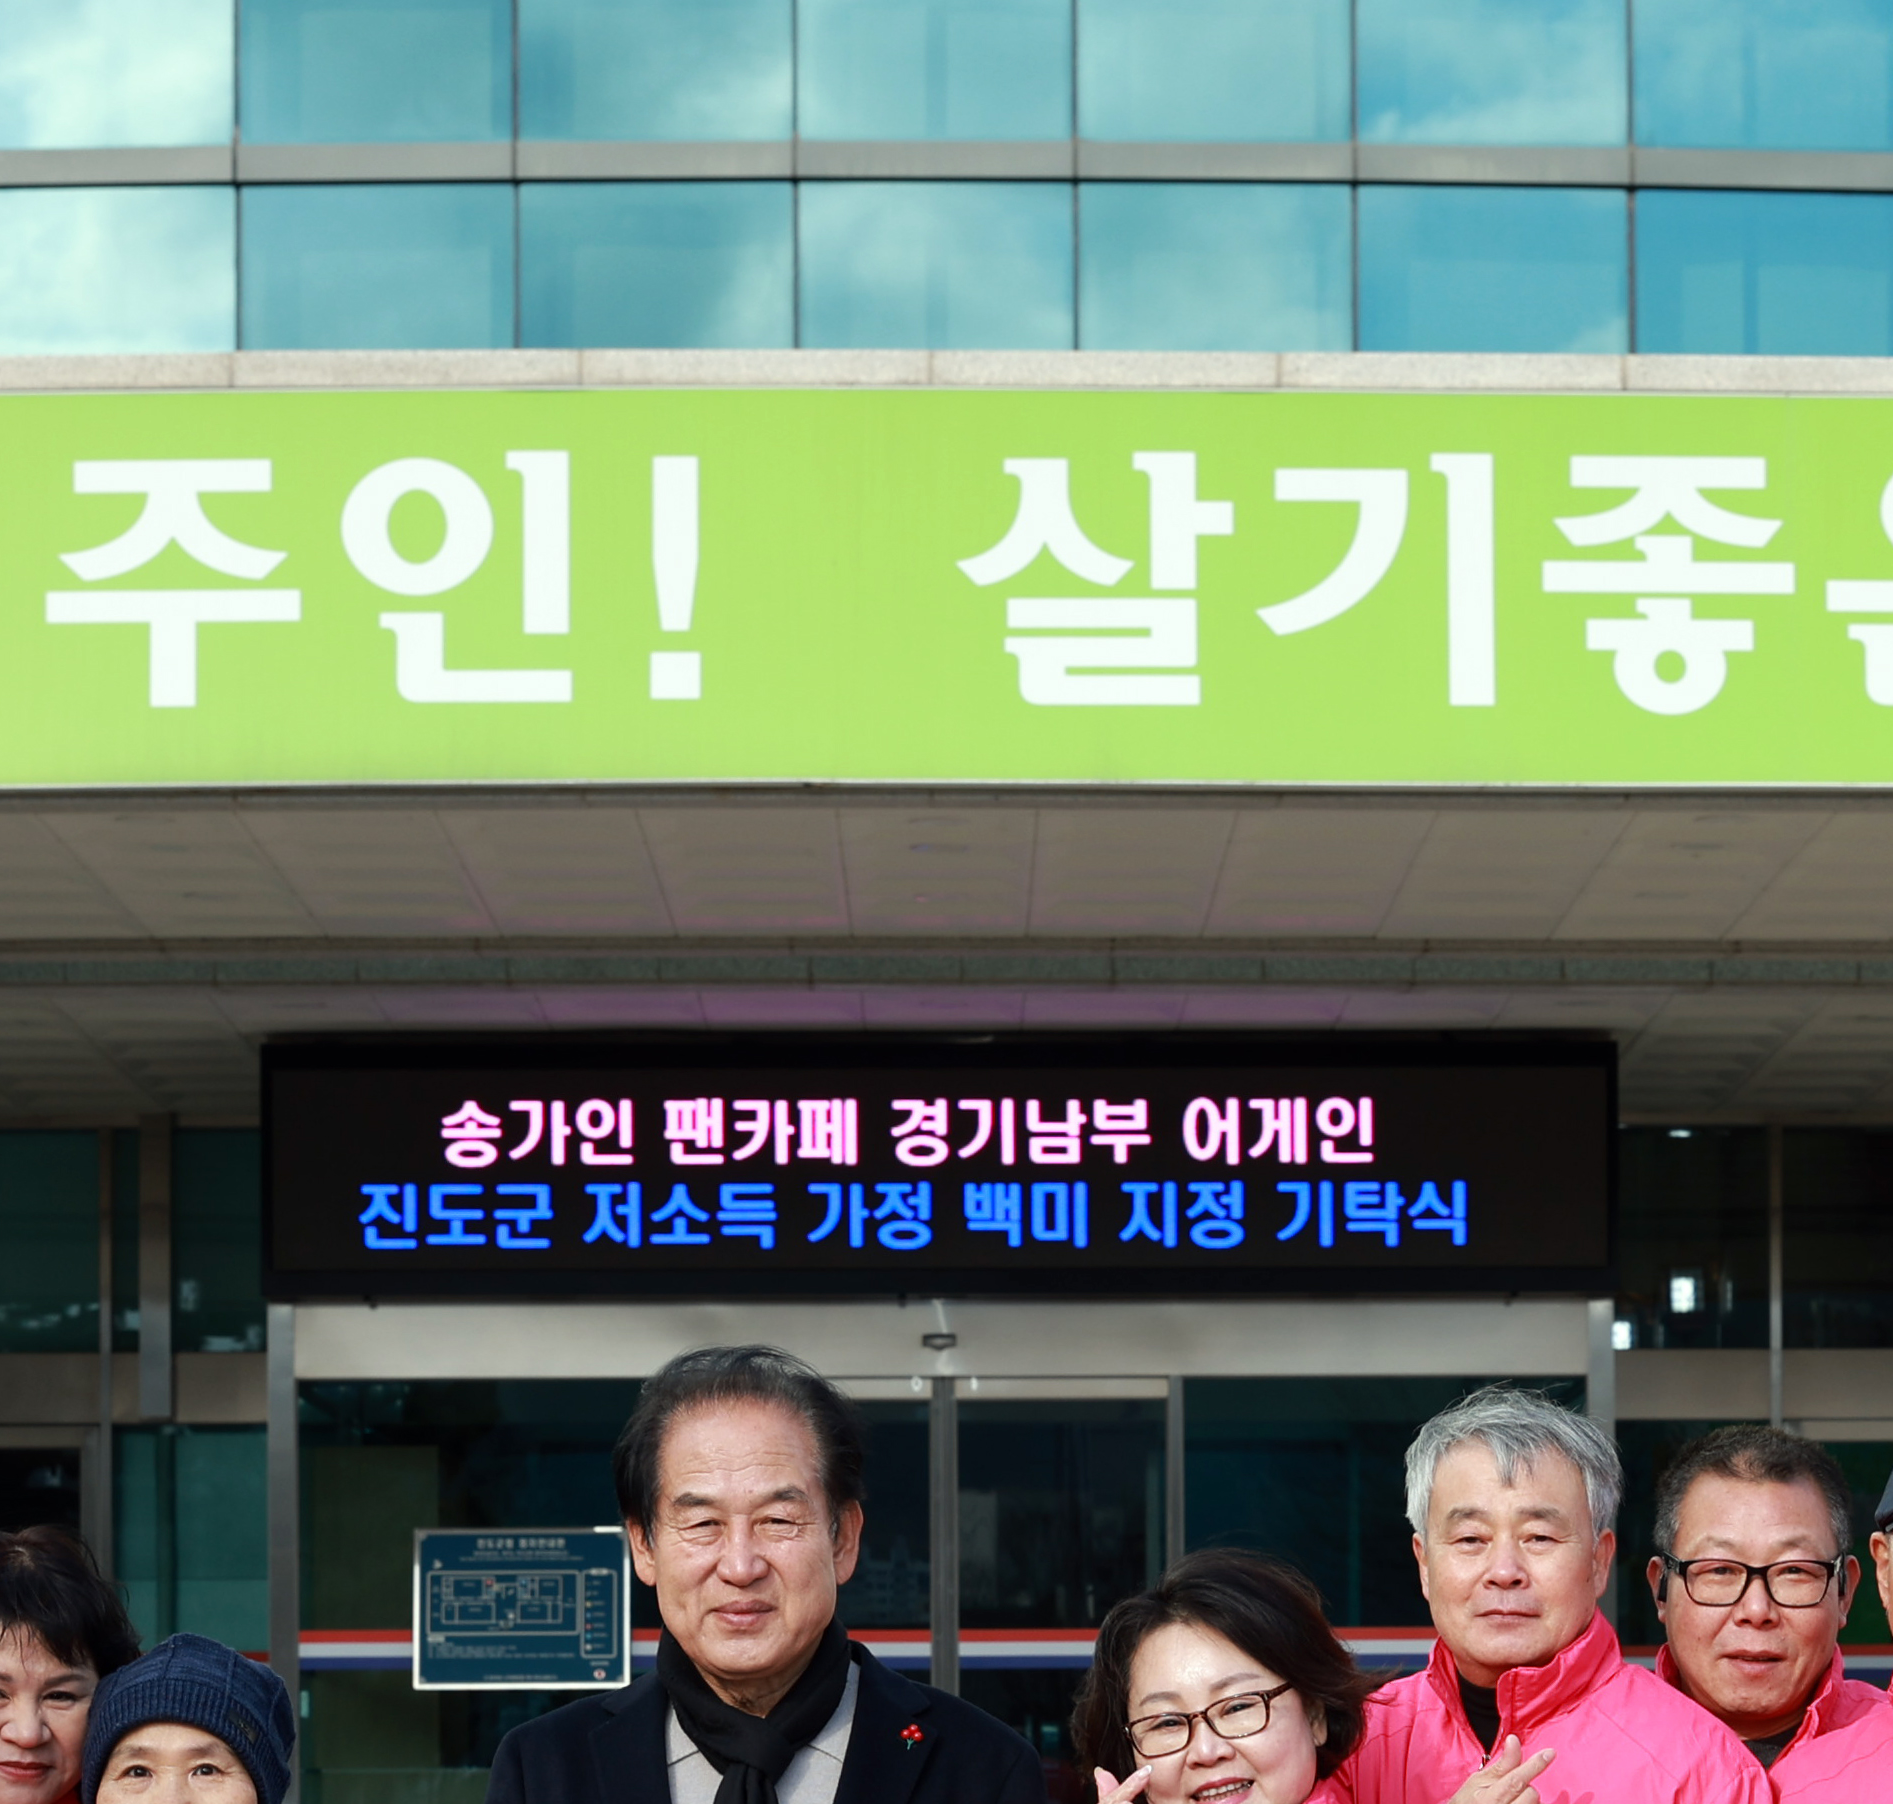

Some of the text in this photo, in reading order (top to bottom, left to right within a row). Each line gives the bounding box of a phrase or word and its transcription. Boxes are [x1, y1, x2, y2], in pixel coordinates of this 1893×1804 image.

[46, 451, 700, 707] 주인!
[442, 1098, 1373, 1167] 송가인 팬카페 경기남부 어게인
[359, 1181, 1466, 1249] 진도군 저소득 가정 백미 지정 기탁식
